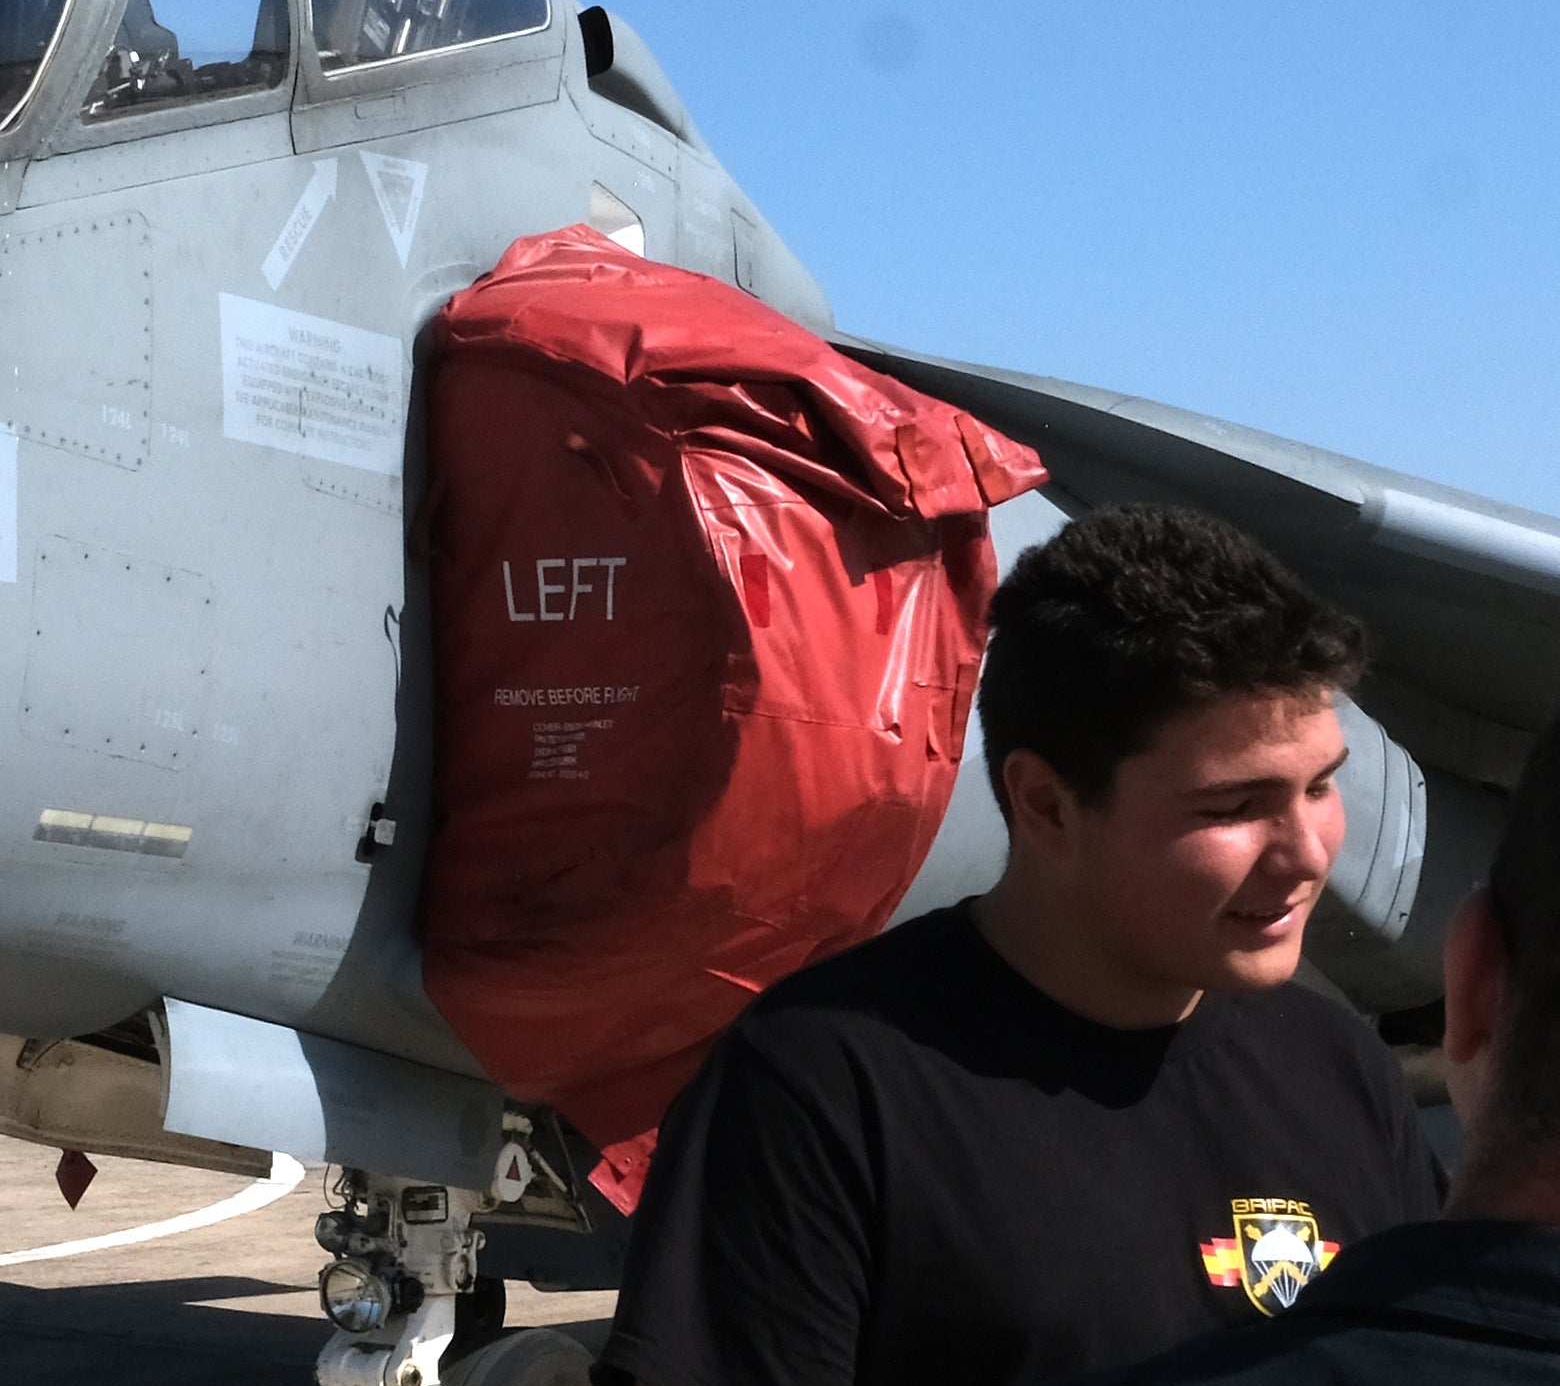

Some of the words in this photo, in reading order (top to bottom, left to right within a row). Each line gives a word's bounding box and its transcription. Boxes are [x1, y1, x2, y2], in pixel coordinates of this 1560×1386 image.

[502, 557, 627, 621] LEFT
[494, 688, 546, 706] REMOVE
[548, 687, 602, 705] BEFORE
[604, 685, 642, 704] FLIGHT
[1231, 1198, 1314, 1216] BRIPAC
